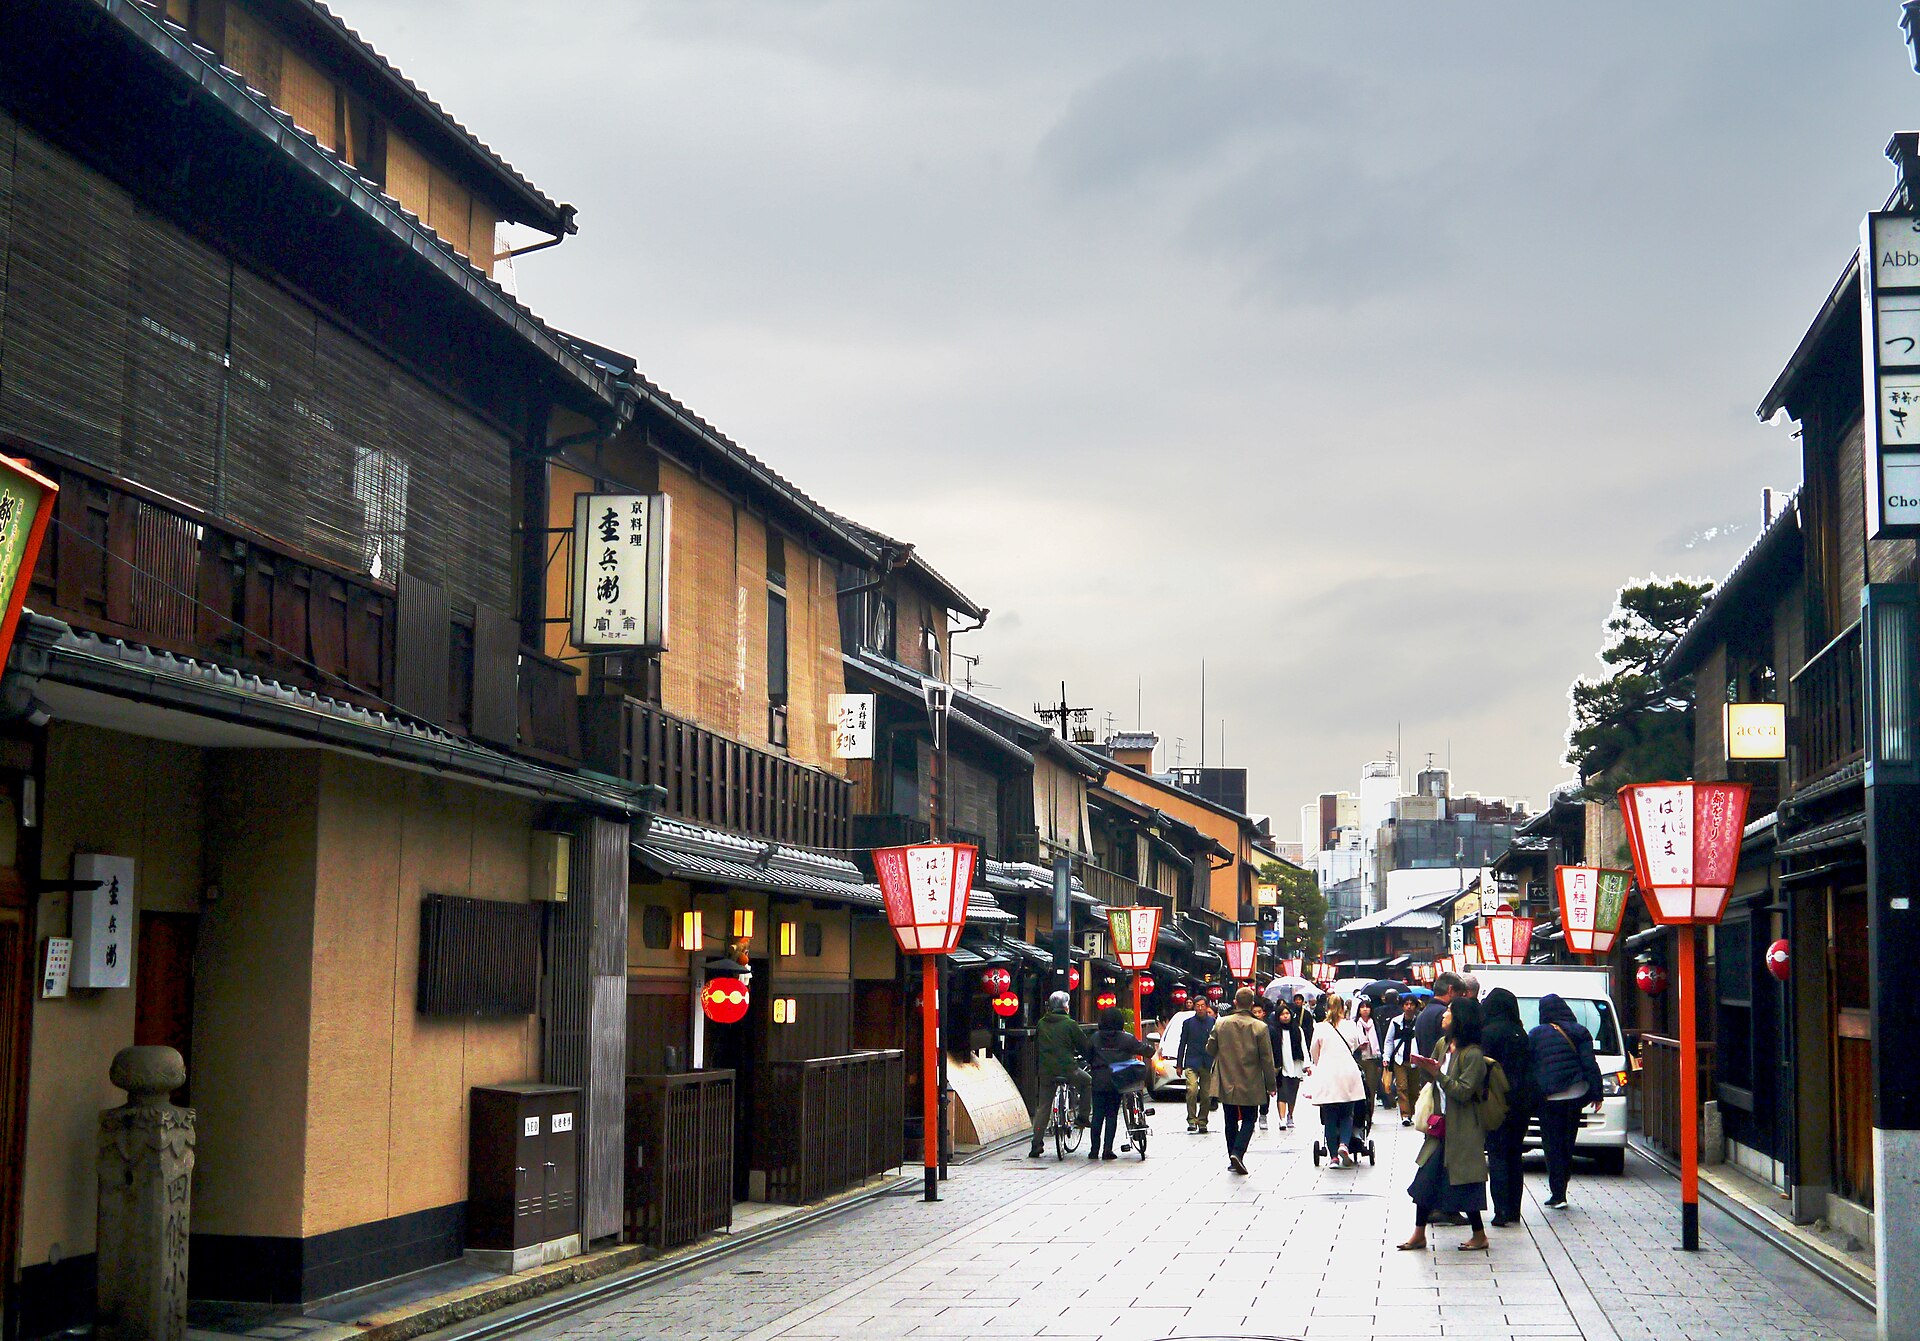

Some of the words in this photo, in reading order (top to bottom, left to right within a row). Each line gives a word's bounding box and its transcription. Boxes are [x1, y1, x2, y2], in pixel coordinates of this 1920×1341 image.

[1882, 250, 1920, 267] Abb
[1888, 495, 1920, 507] Cho
[630, 501, 643, 547] 京料理
[1736, 726, 1777, 736] acca
[1659, 799, 1676, 856] はれま
[926, 858, 938, 902] はれま
[1573, 873, 1588, 923] 月桂冠
